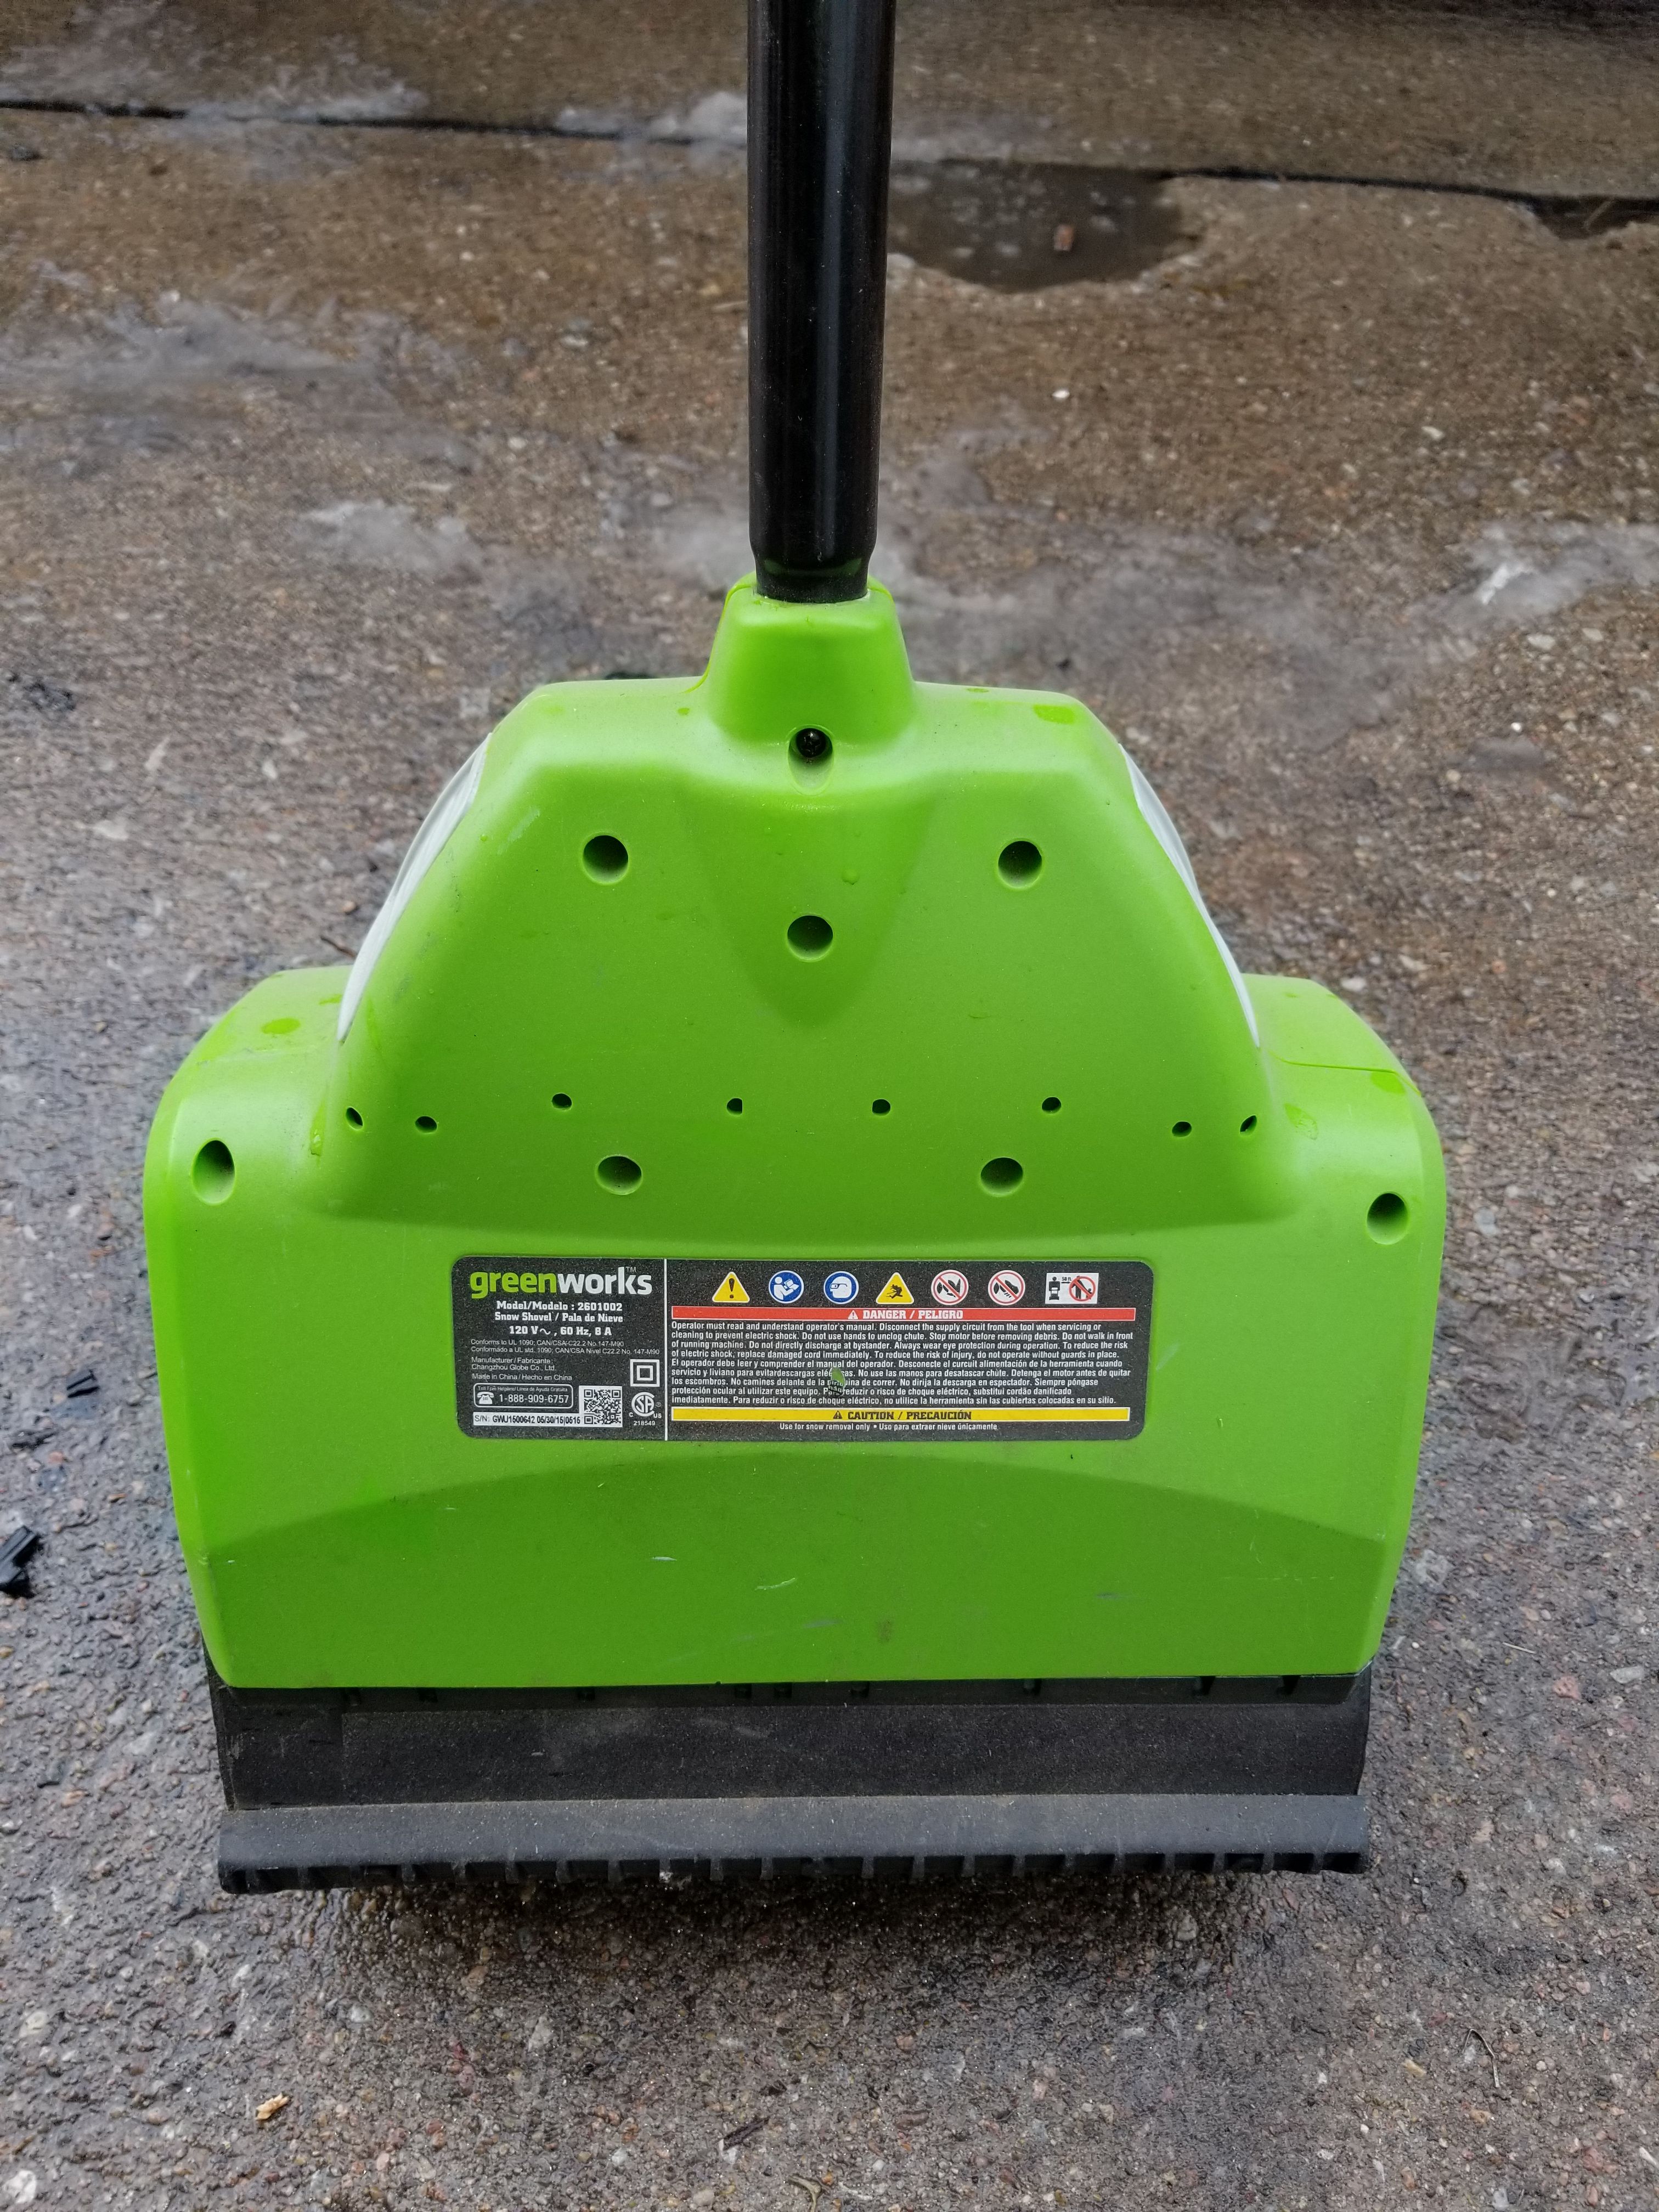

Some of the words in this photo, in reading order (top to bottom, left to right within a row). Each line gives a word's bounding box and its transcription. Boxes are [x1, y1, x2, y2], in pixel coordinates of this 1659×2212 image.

[470, 1266, 653, 1299] greenworks
[496, 1300, 568, 1311] Model/Modelo
[578, 1302, 623, 1311] 2601002
[495, 1312, 519, 1321] Snow
[522, 1312, 552, 1322] Shovel
[562, 1313, 583, 1322] Pala
[585, 1313, 595, 1322] de
[598, 1313, 623, 1323] Nieve
[862, 1310, 907, 1319] DANGER
[918, 1310, 963, 1319] PELIGRO
[509, 1325, 528, 1334] 120
[560, 1327, 573, 1335] 60
[576, 1327, 592, 1337] Hz,
[595, 1327, 601, 1335] 8
[604, 1327, 612, 1336] A
[672, 1321, 704, 1331] Operator
[707, 1322, 725, 1330] must
[746, 1322, 759, 1330] and
[806, 1323, 844, 1333] operator's
[936, 1323, 960, 1333] supply
[1058, 1323, 1091, 1333] servicing
[711, 1350, 735, 1358] shock,
[738, 1351, 765, 1359] replace
[768, 1351, 802, 1359] damaged
[823, 1351, 871, 1360] immediately.
[952, 1351, 974, 1360] injury,
[1002, 1351, 1030, 1360] operate
[1061, 1351, 1086, 1360] guards
[1097, 1351, 1119, 1360] place.
[681, 1359, 715, 1368] operador
[760, 1359, 805, 1369] comprender
[860, 1360, 895, 1369] operador.
[499, 1393, 569, 1403] 1-888-909-6757
[819, 1397, 845, 1406] choque
[848, 1397, 882, 1406] eléctrico,
[848, 1411, 894, 1420] CAUTION
[906, 1409, 972, 1420] PRECAUCIÓN
[856, 1423, 870, 1431] only
